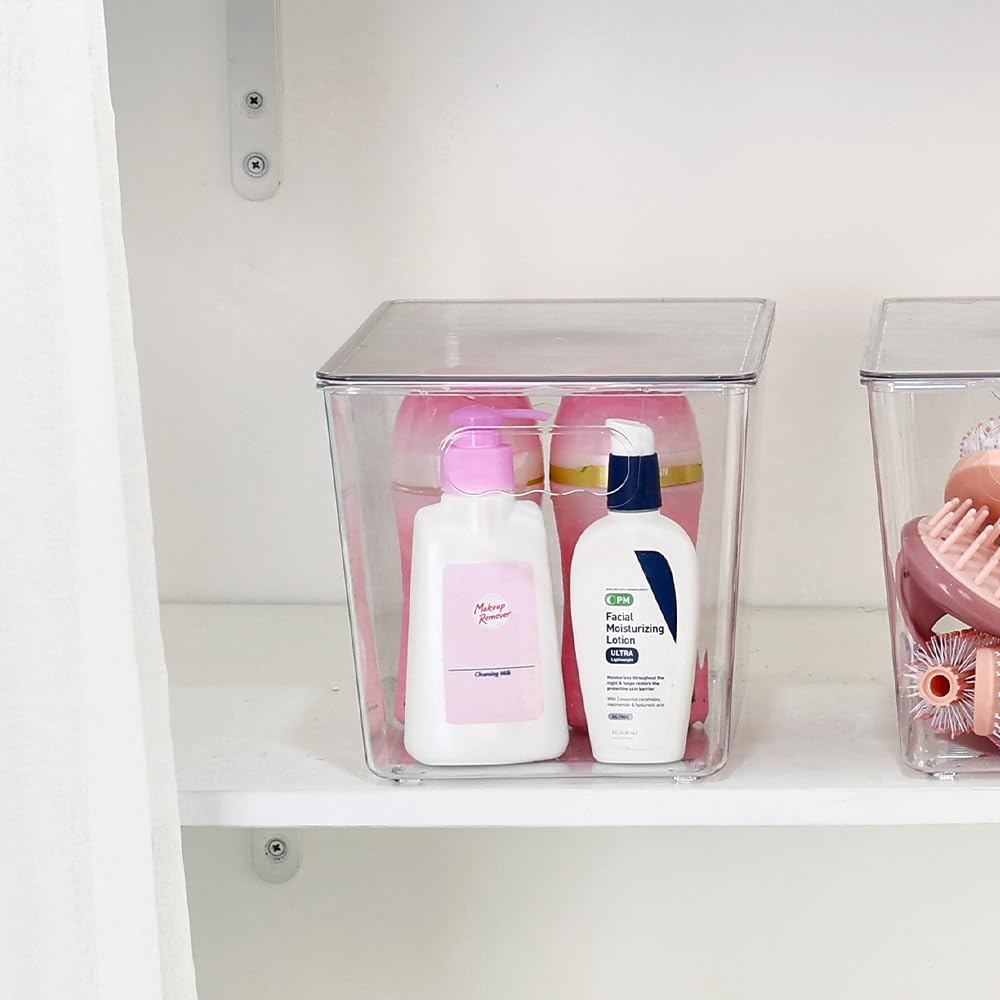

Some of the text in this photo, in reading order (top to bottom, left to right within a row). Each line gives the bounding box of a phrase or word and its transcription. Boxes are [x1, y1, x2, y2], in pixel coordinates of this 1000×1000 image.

[616, 596, 630, 605] PM
[474, 602, 506, 614] Makeup
[478, 611, 512, 624] Remover
[606, 612, 634, 621] Facial
[606, 624, 665, 635] Moisturizing
[606, 636, 636, 645] Lotion
[610, 649, 634, 657] ULTRA
